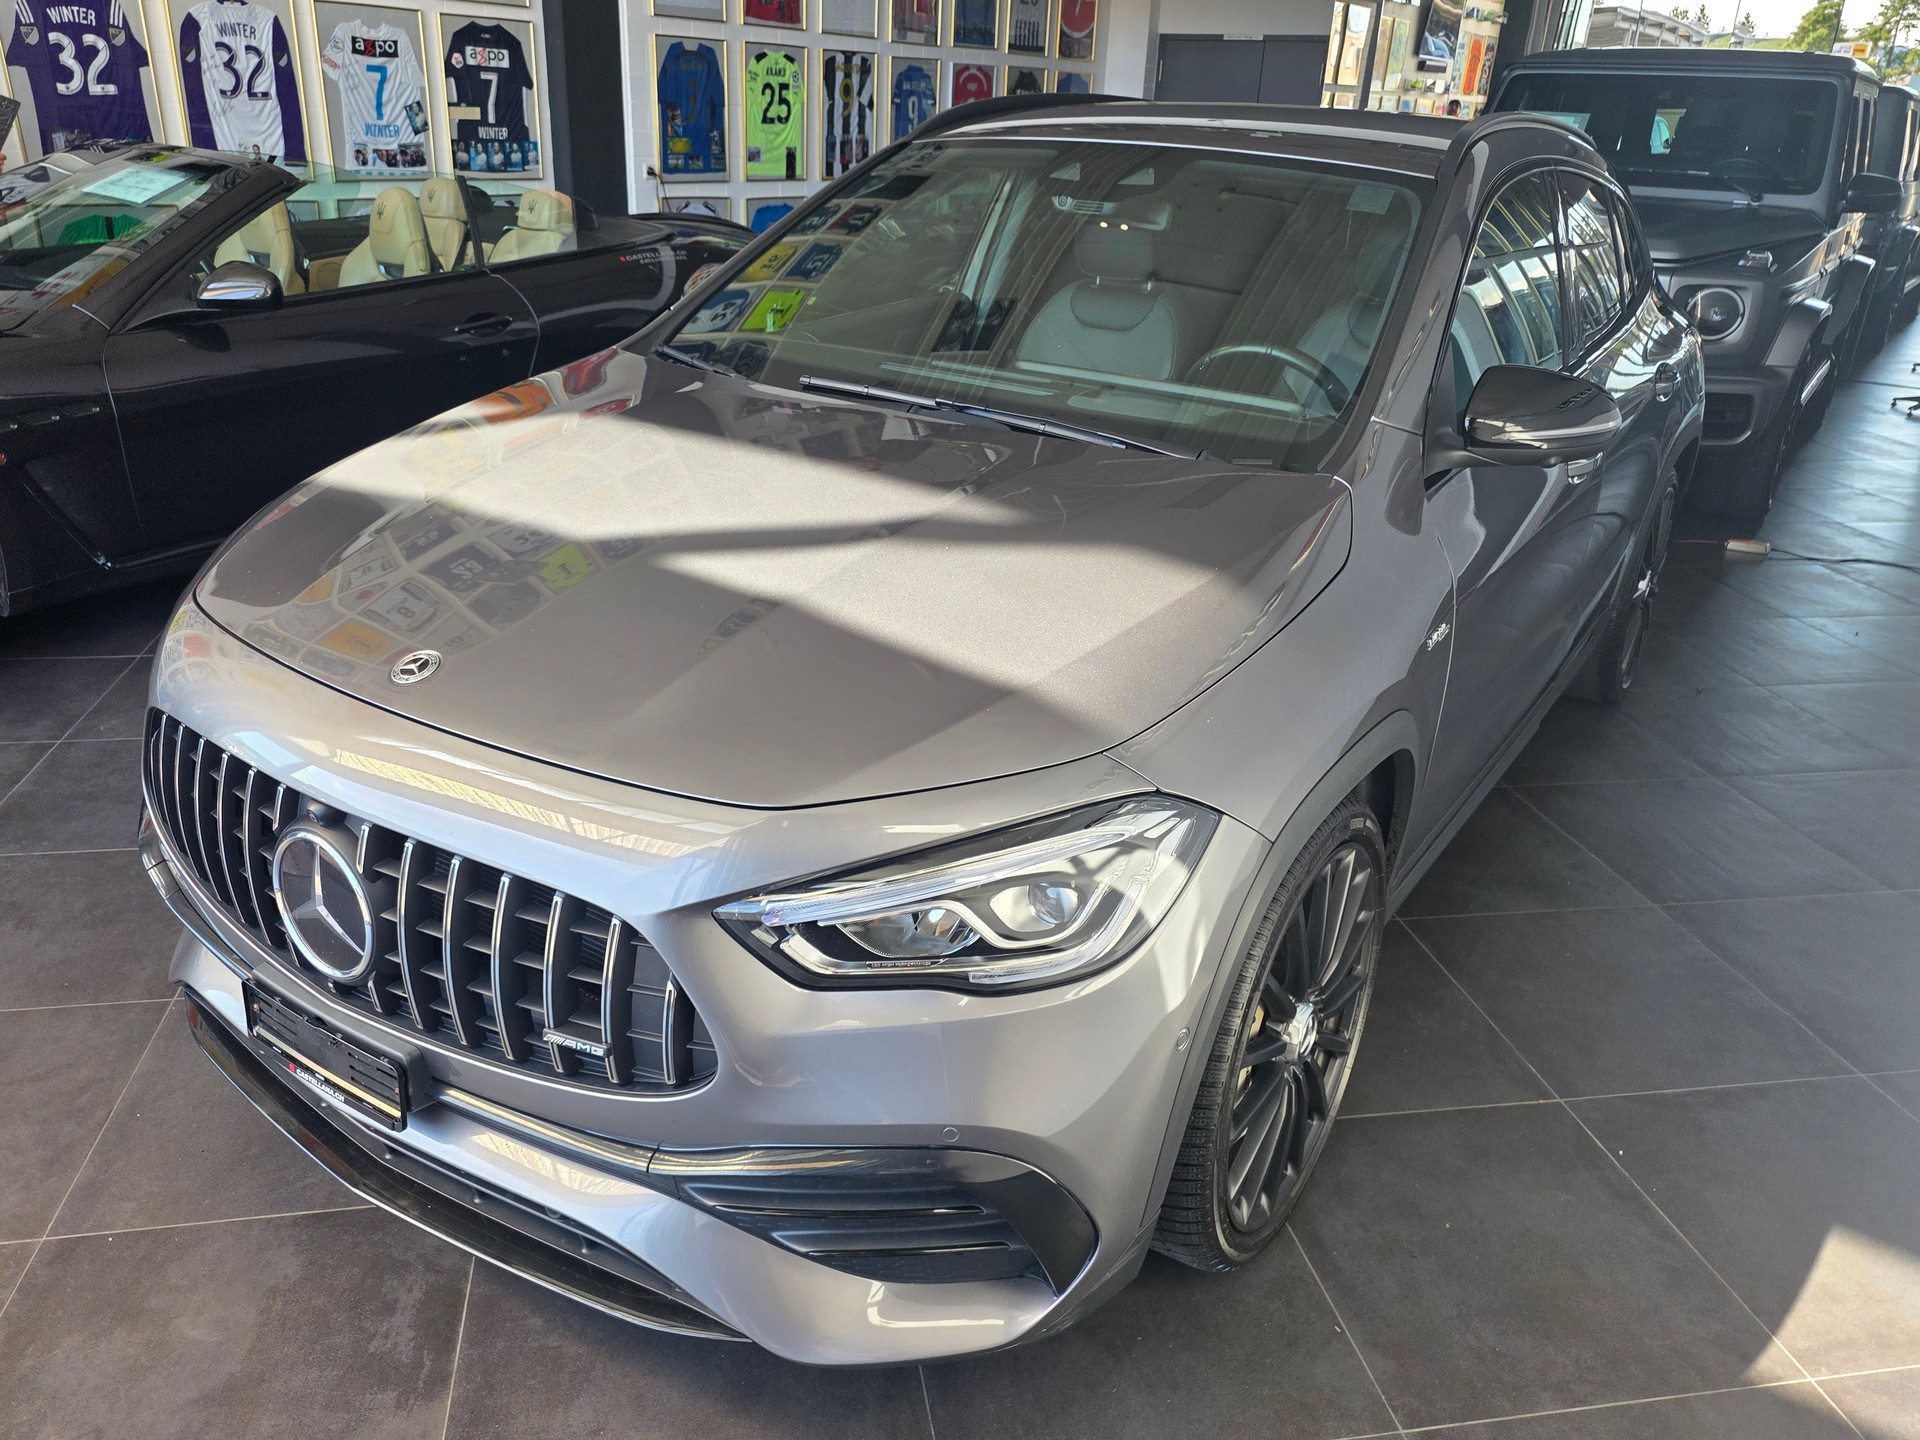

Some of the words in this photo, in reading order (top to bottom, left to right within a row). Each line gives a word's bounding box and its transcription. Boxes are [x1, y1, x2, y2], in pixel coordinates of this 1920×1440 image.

[47, 6, 96, 26] WINTER
[216, 22, 257, 40] WINTER
[48, 32, 118, 96] 32
[214, 41, 273, 100] 32
[366, 64, 388, 121] 7
[480, 71, 499, 124] 7
[761, 82, 791, 124] 25
[364, 123, 400, 138] WINTER
[478, 126, 509, 140] WINTER
[562, 1039, 604, 1056] AMG
[296, 1068, 345, 1103] CASTELLANA.CH
